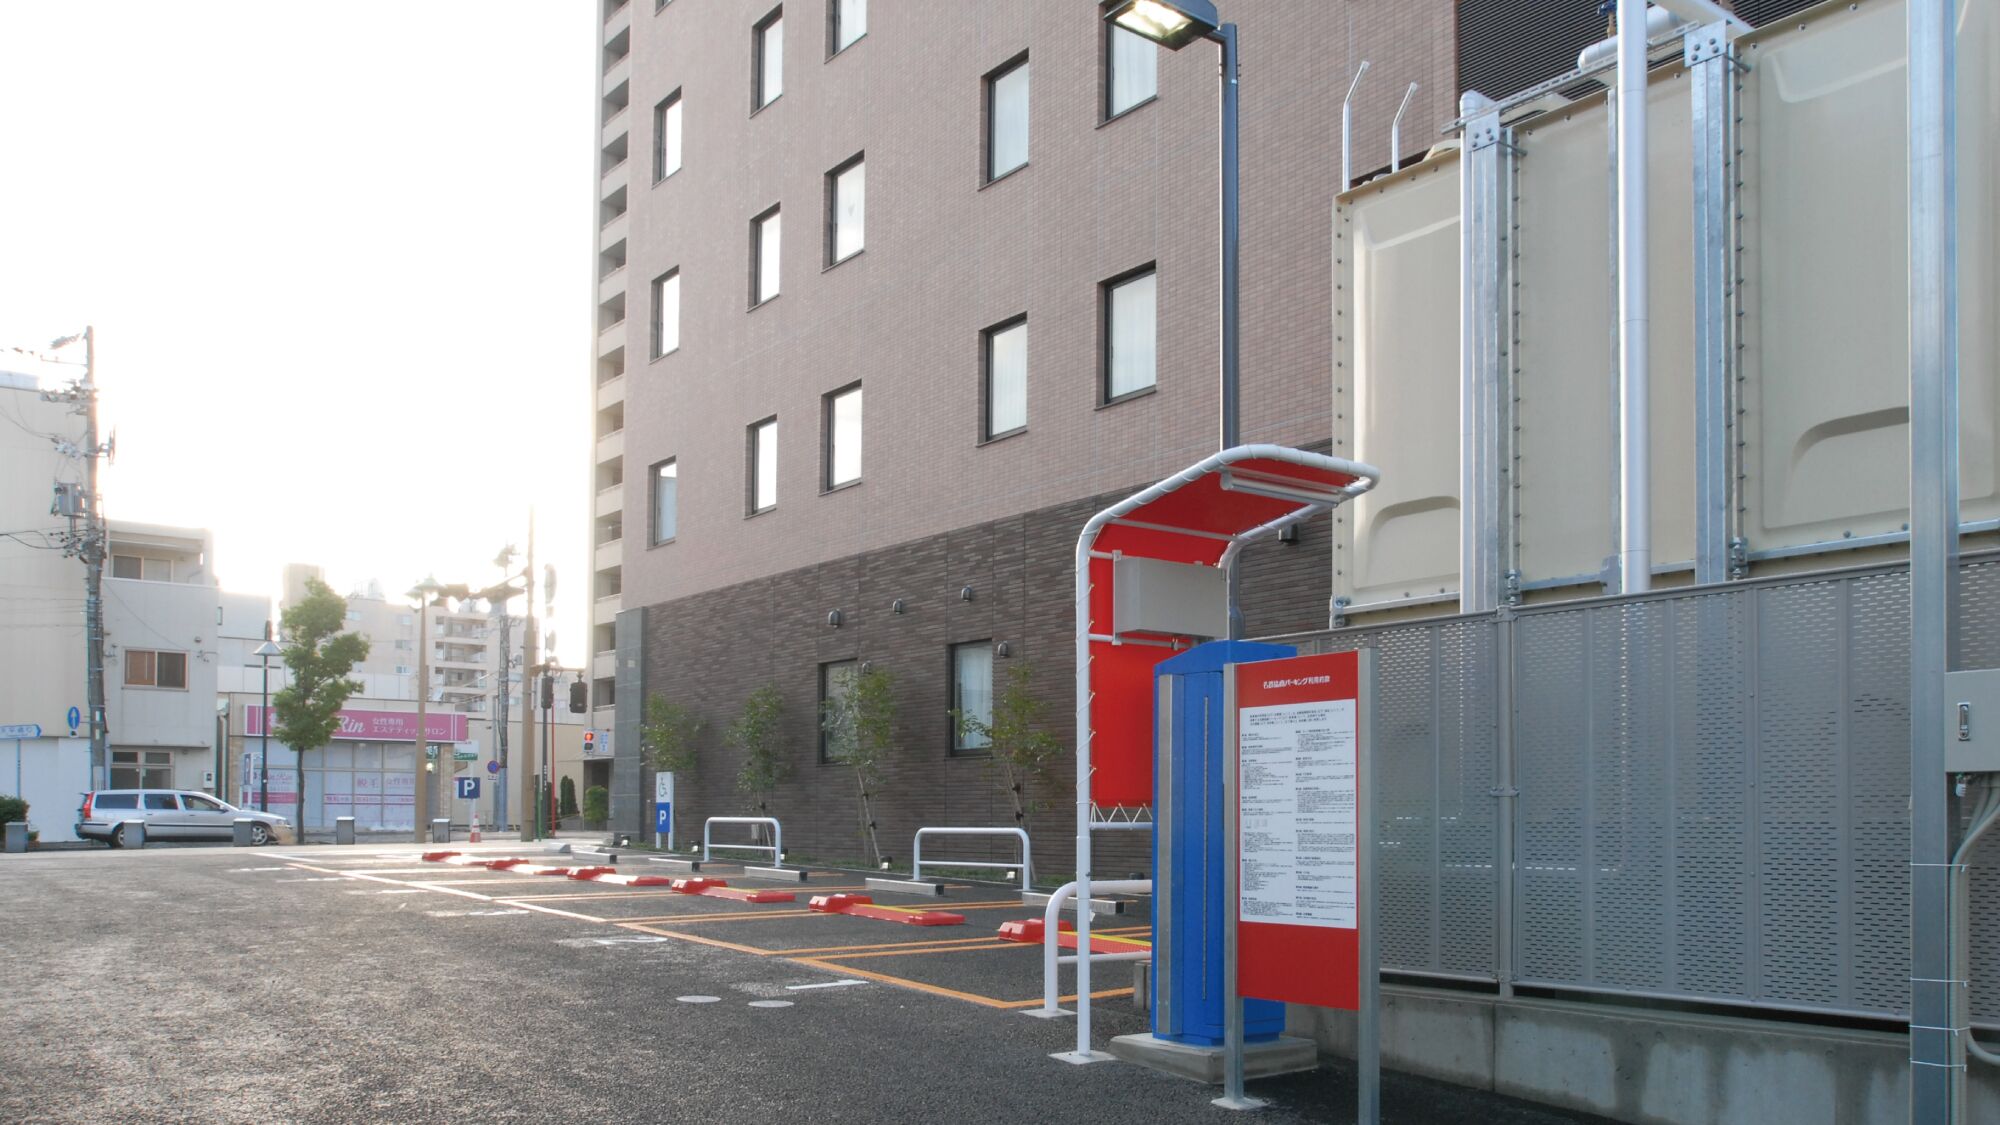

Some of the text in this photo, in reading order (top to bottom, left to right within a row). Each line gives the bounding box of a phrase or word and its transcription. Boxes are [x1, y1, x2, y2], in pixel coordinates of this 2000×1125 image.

[373, 726, 447, 736] エステティッサロン
[463, 779, 476, 797] P
[659, 809, 667, 825] P
